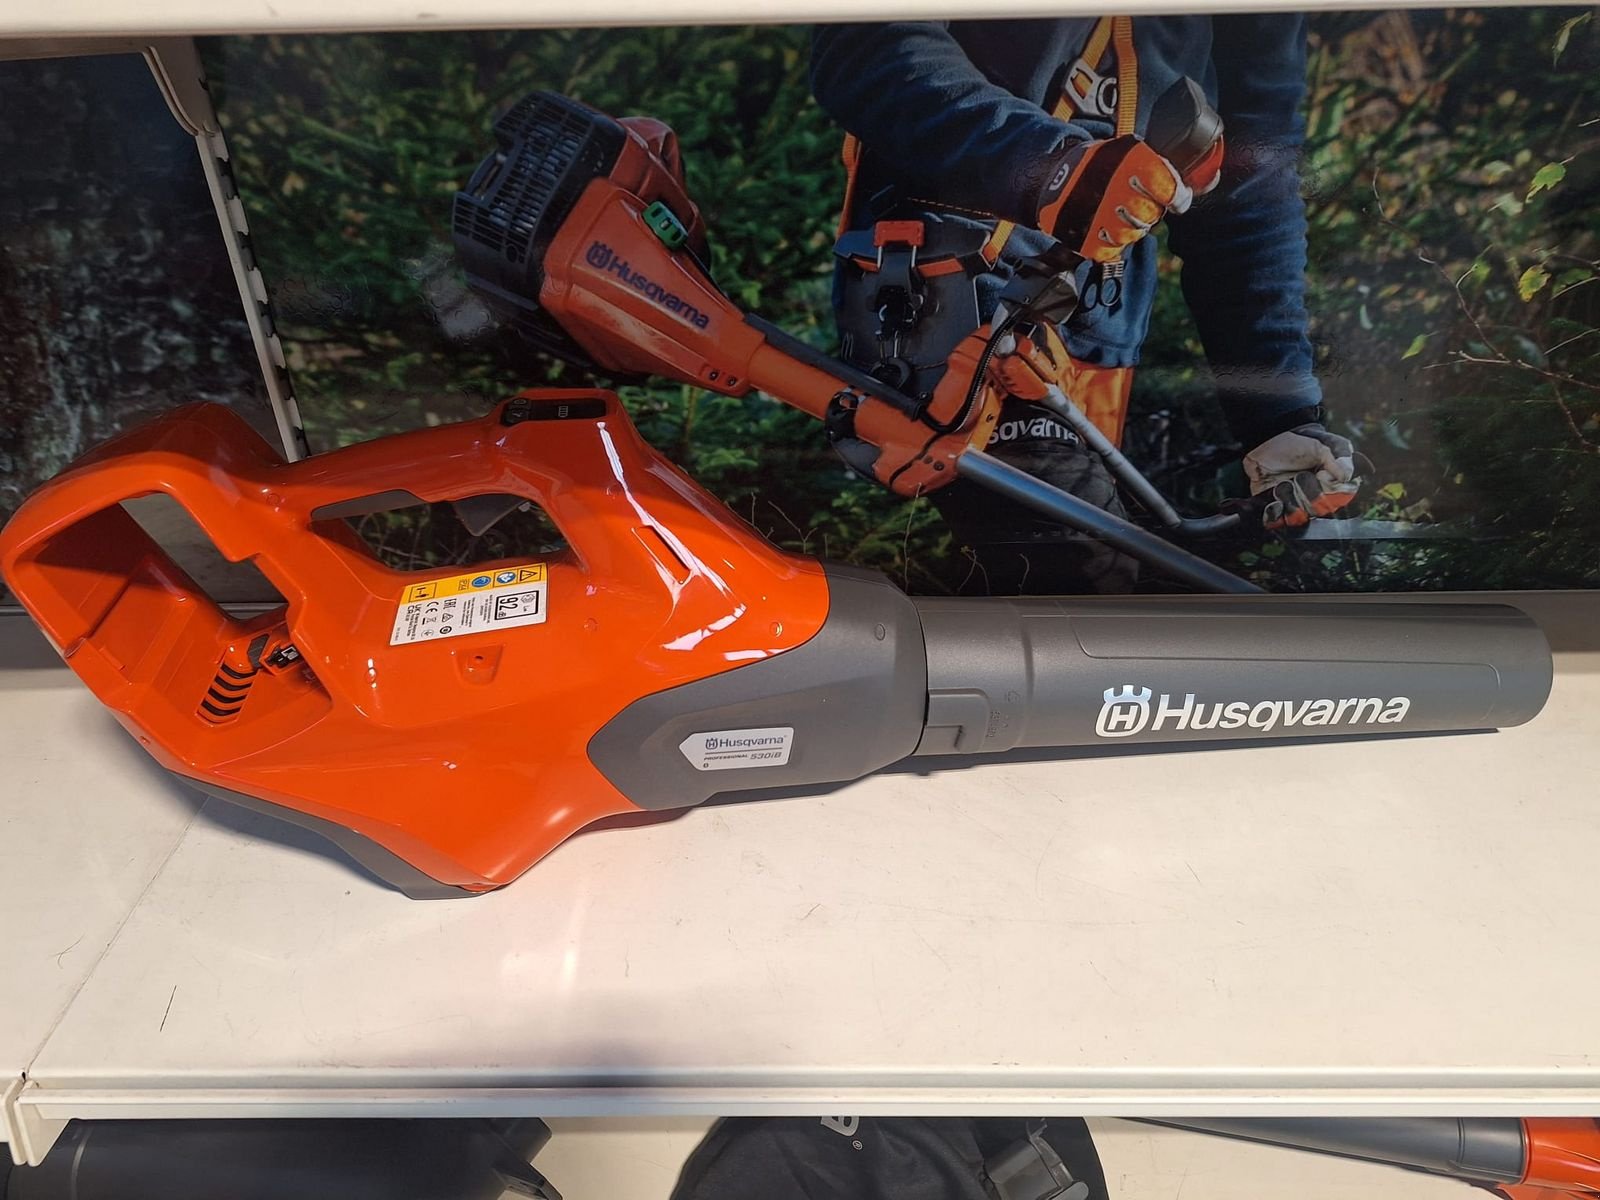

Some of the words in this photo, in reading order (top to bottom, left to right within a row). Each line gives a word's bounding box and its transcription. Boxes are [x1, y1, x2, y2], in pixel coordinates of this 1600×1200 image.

[607, 256, 710, 330] Husqvarna
[499, 597, 519, 611] 92
[1150, 693, 1411, 732] Husqvarna
[719, 736, 784, 748] Husqvarna
